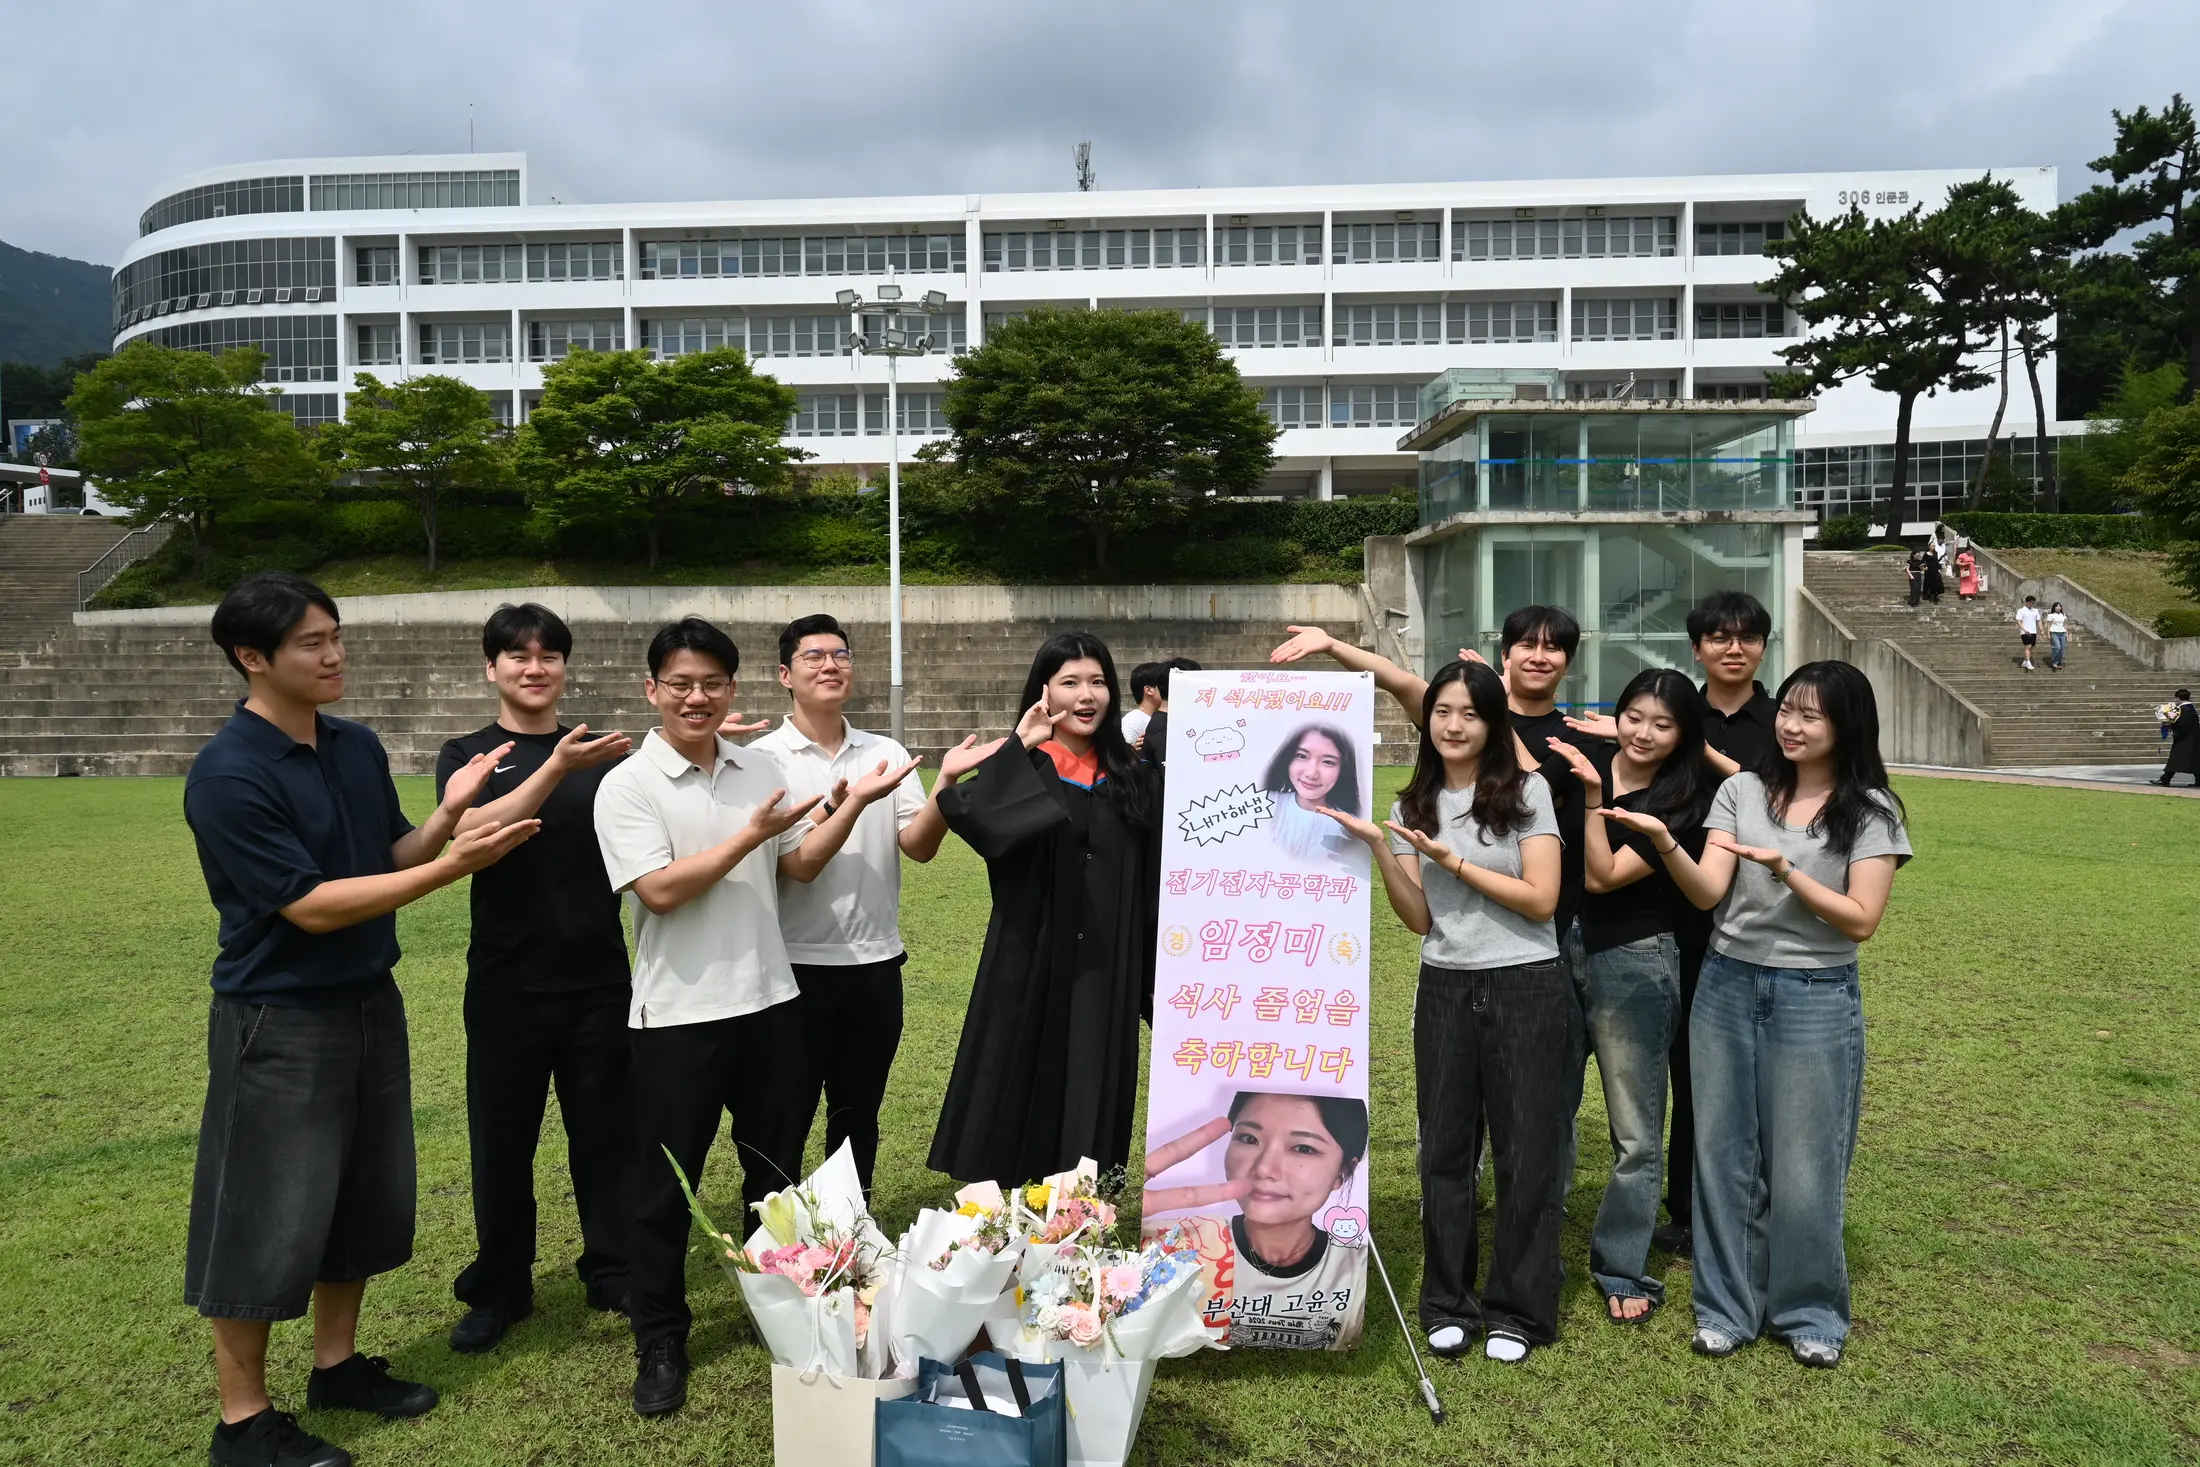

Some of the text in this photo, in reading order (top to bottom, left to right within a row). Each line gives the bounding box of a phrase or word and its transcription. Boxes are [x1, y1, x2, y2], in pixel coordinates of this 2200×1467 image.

[1838, 190, 1909, 205] 306 인문관
[1195, 687, 1352, 711] 저 석사됐어요!!!
[1189, 796, 1263, 832] 내가해냄
[1166, 868, 1358, 904] 전기전자공학과
[1200, 918, 1325, 967] 임정미
[1336, 939, 1353, 960] 축
[1168, 982, 1360, 1027] 석사 졸업을
[1173, 1038, 1354, 1084] 축하합니다
[1202, 1288, 1351, 1321] 부산대 고윤정
